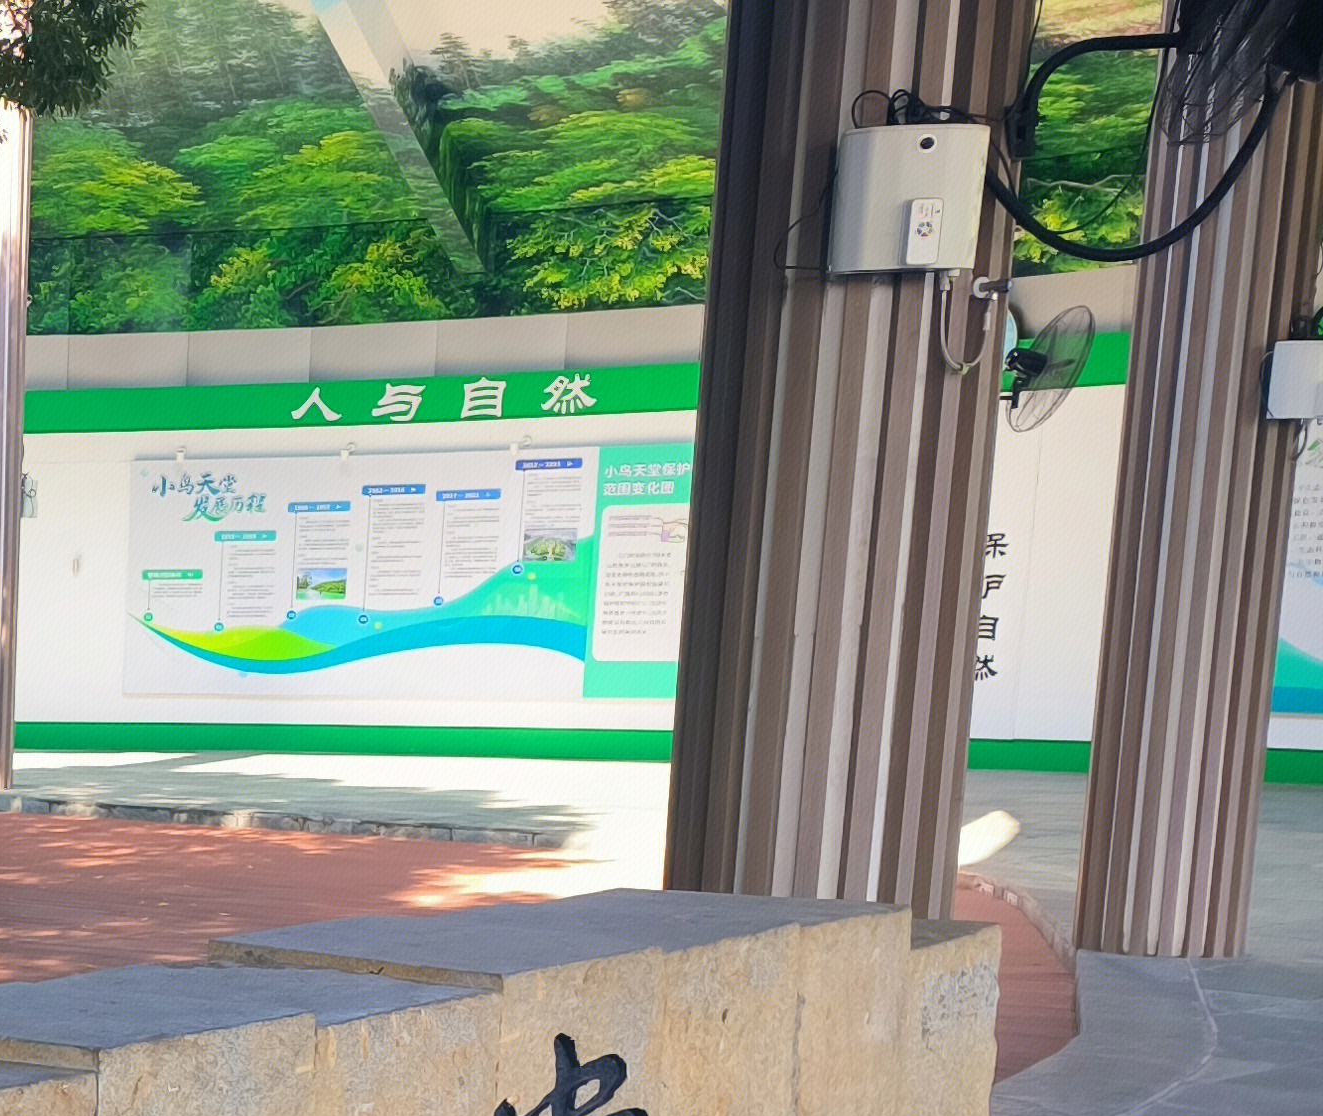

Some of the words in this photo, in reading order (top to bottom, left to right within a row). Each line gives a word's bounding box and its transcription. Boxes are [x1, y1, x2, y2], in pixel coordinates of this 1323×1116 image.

[291, 372, 598, 422] 人与自然
[605, 461, 690, 479] 小鸟天堂保护
[151, 472, 239, 498] 小鸟天堂
[182, 493, 268, 523] 发展历程
